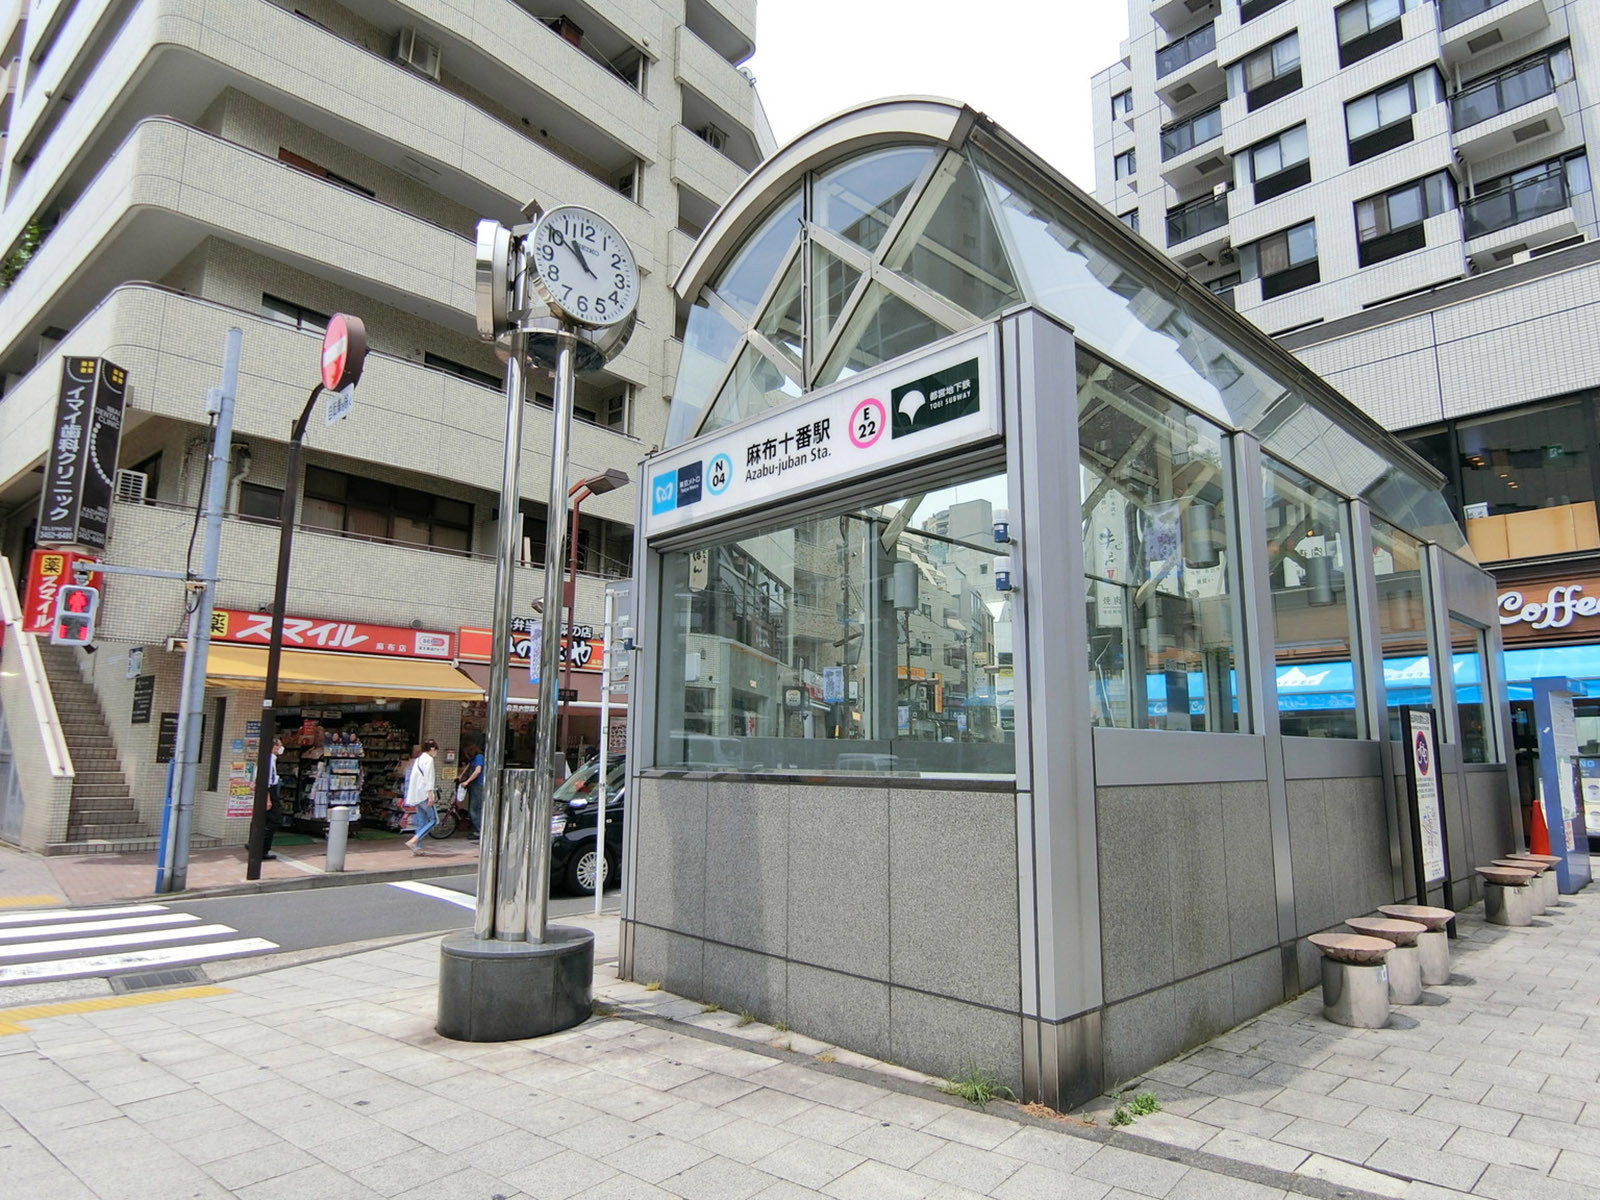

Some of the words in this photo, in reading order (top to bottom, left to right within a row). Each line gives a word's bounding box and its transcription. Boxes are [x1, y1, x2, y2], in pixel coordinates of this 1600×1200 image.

[548, 225, 564, 246] 10
[565, 219, 577, 238] 11
[580, 222, 596, 243] 12
[542, 245, 554, 262] 9
[579, 243, 600, 257] SEIKO
[610, 253, 622, 270] 2
[547, 264, 560, 282] 8
[614, 273, 626, 290] 3
[561, 284, 573, 300] 7
[608, 290, 619, 306] 4
[576, 295, 588, 312] 6
[594, 297, 606, 314] 5
[929, 379, 971, 402] 都営地下鉄
[929, 401, 944, 411] TOEI
[944, 390, 971, 405] SUBWAY
[95, 407, 120, 423] DENTAL
[98, 415, 120, 430] CLINIC
[863, 407, 870, 421] E
[858, 420, 875, 439] 22
[746, 418, 831, 467] 麻布十番駅
[50, 386, 86, 521] イマイ歯科クリニック
[715, 460, 723, 473] N
[745, 453, 807, 483] Azabu-juban
[811, 447, 831, 462] Sta.
[712, 473, 726, 487] 04
[43, 557, 61, 574] 薬
[34, 575, 58, 628] スマイル
[1497, 584, 1600, 630] Coffe
[210, 613, 226, 634] 薬
[235, 614, 370, 648] スマイル
